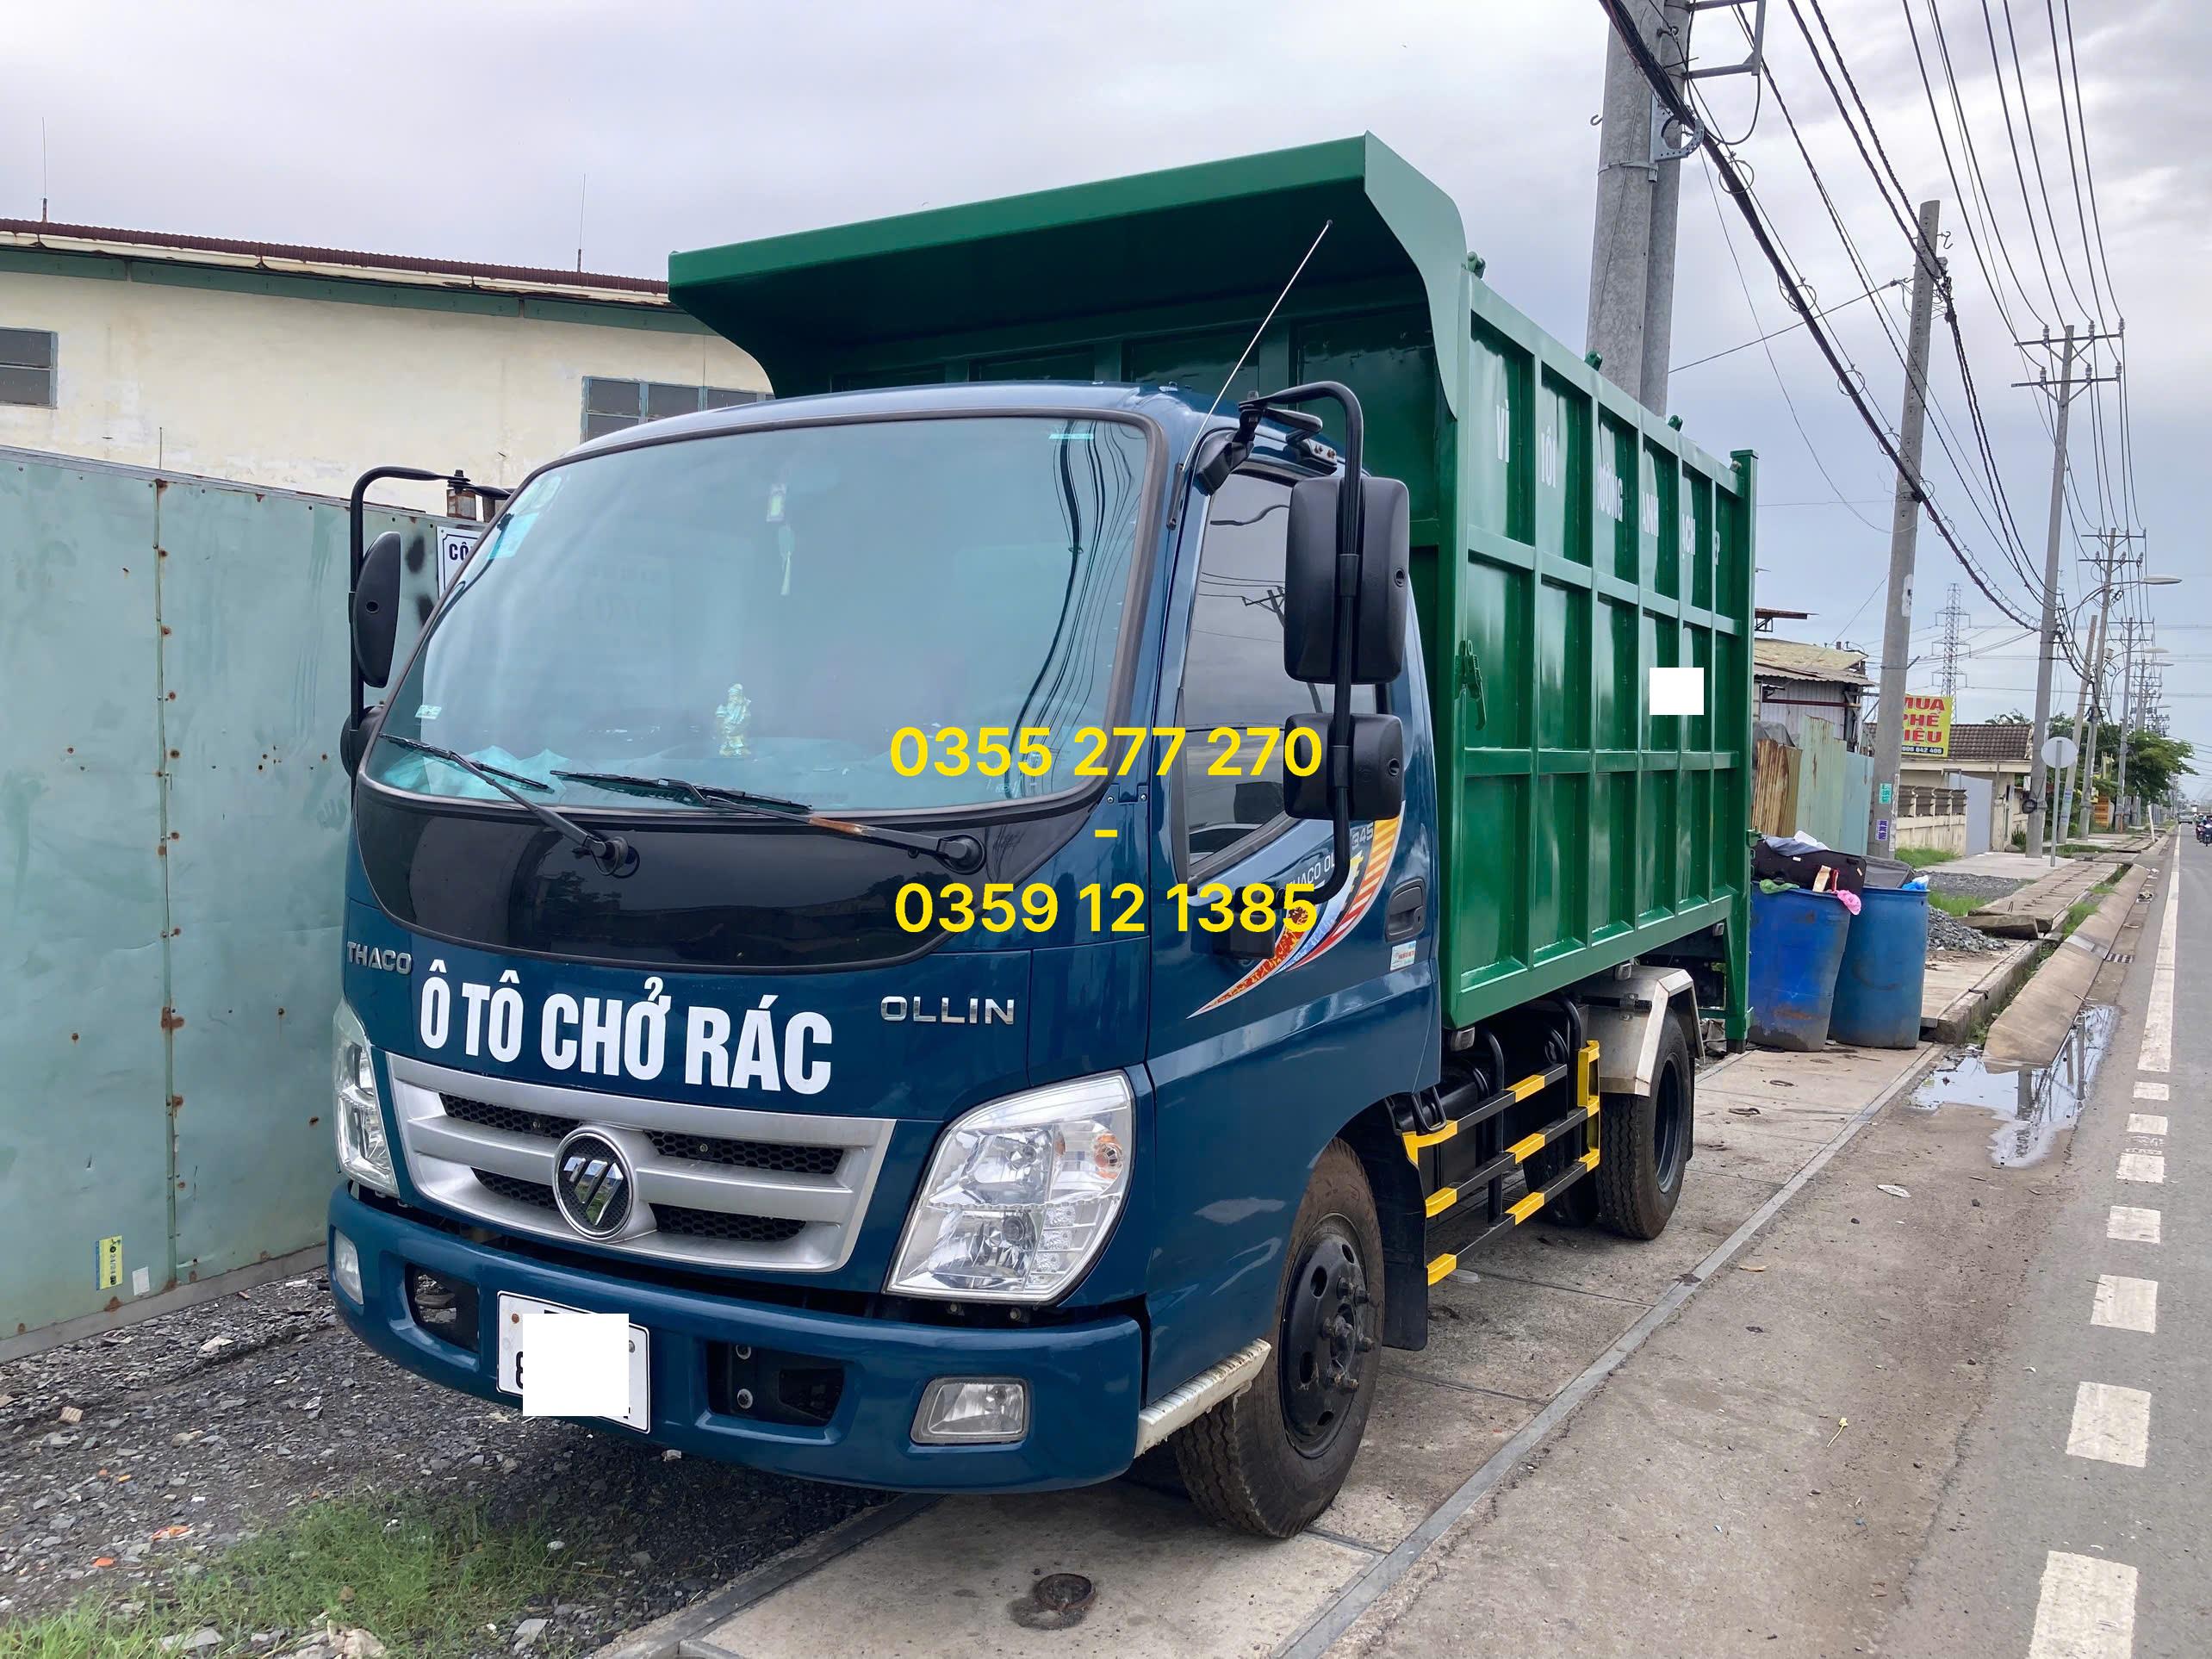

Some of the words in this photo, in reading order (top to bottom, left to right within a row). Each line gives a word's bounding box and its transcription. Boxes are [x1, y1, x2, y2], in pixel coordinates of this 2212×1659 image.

[449, 542, 469, 561] CÔ
[347, 941, 412, 974] THACO
[880, 996, 1015, 1025] OLLIN
[420, 959, 451, 1049] Ô
[462, 969, 524, 1063] TÔ
[541, 976, 672, 1081] CHỞ
[685, 994, 833, 1095] RÁC
